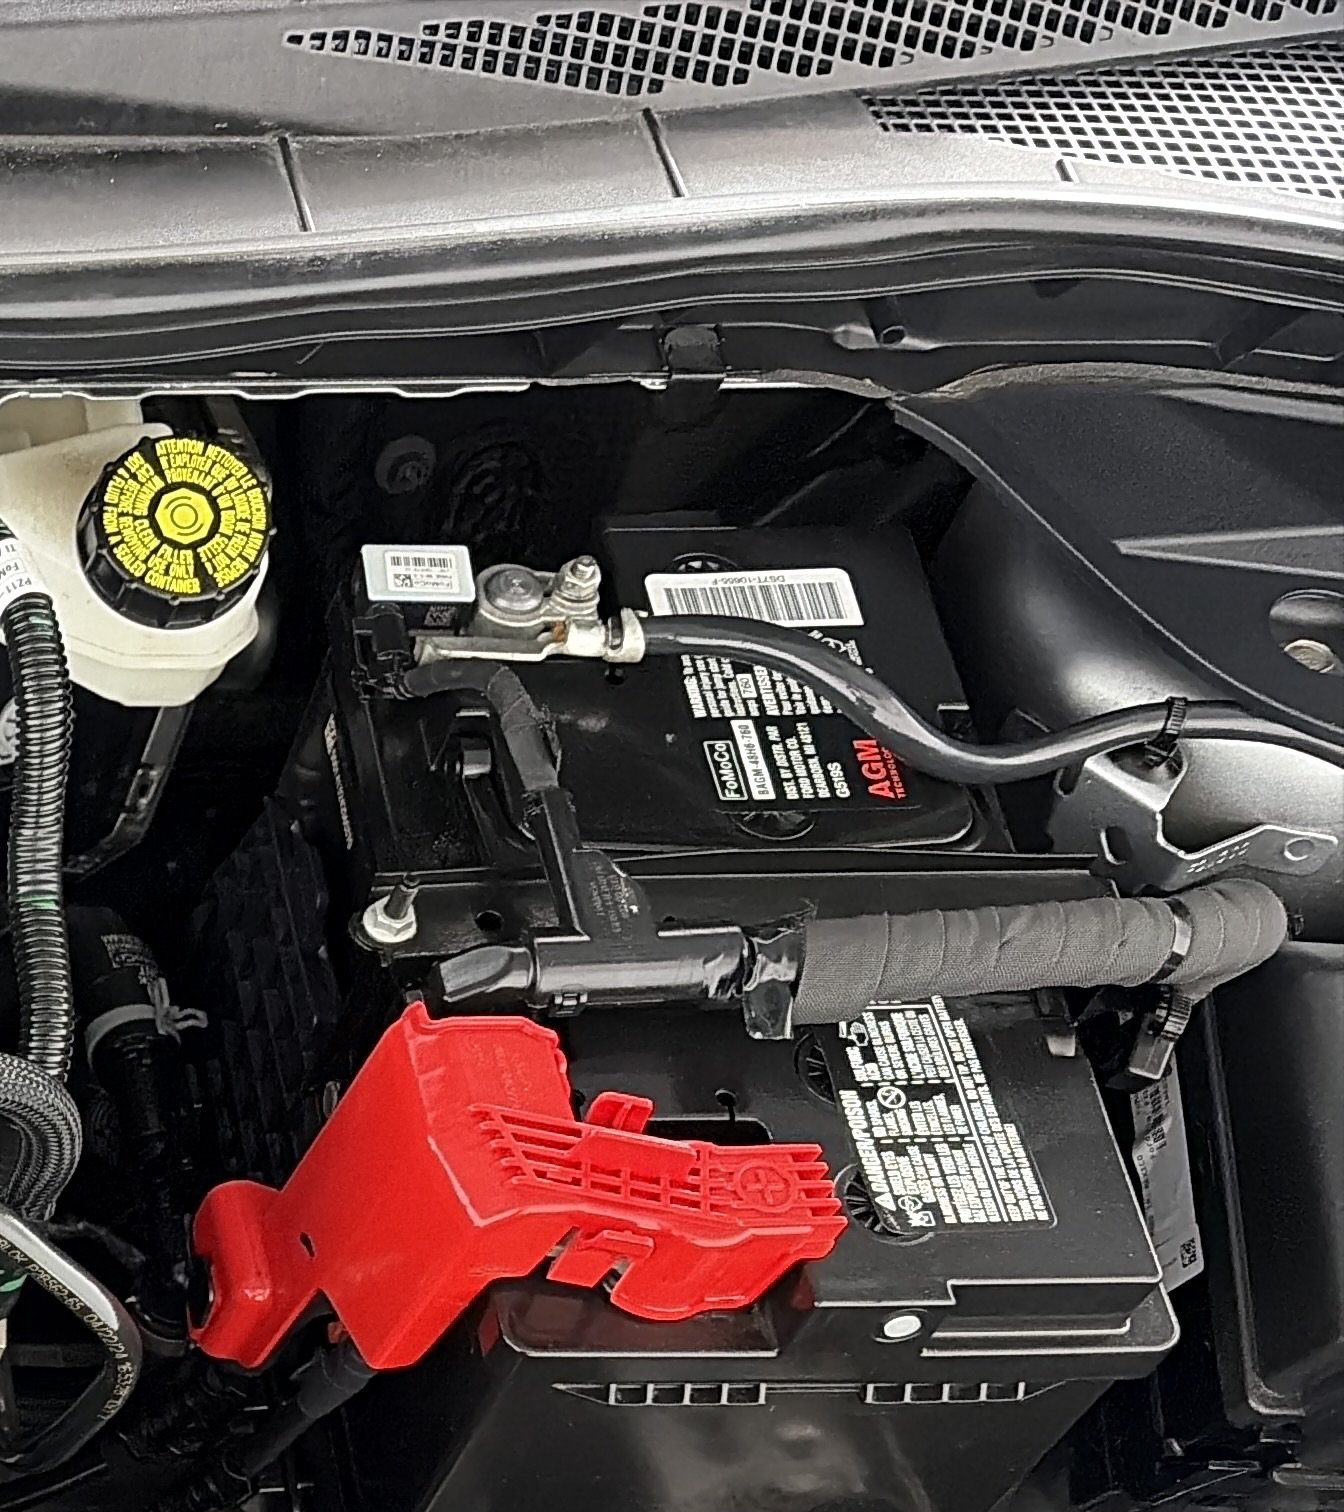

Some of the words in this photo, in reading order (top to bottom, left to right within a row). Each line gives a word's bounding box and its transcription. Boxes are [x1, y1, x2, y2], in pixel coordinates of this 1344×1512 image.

[155, 438, 204, 456] ATTENTION
[124, 451, 145, 473] DOT
[135, 463, 154, 482] CAP
[103, 475, 125, 503] FLUID
[117, 478, 140, 514] BEFORE
[132, 474, 165, 515] WARNING
[102, 506, 118, 533] FROM
[118, 516, 150, 560] REMOVING
[134, 518, 160, 550] CLEAN
[112, 543, 146, 577] SEALED
[147, 553, 168, 573] USE
[157, 543, 192, 563] FILLER
[144, 570, 200, 593] CONTAINER
[169, 562, 194, 578] ONLY
[742, 678, 752, 695] 760
[785, 735, 799, 750] CO.
[714, 742, 741, 799] FoMoCo
[790, 749, 808, 778] MOTOR
[852, 739, 895, 800] AGM
[881, 746, 909, 800] TECHNOLO
[798, 777, 815, 800] FORD
[839, 1089, 888, 1193] DANGER/POISON
